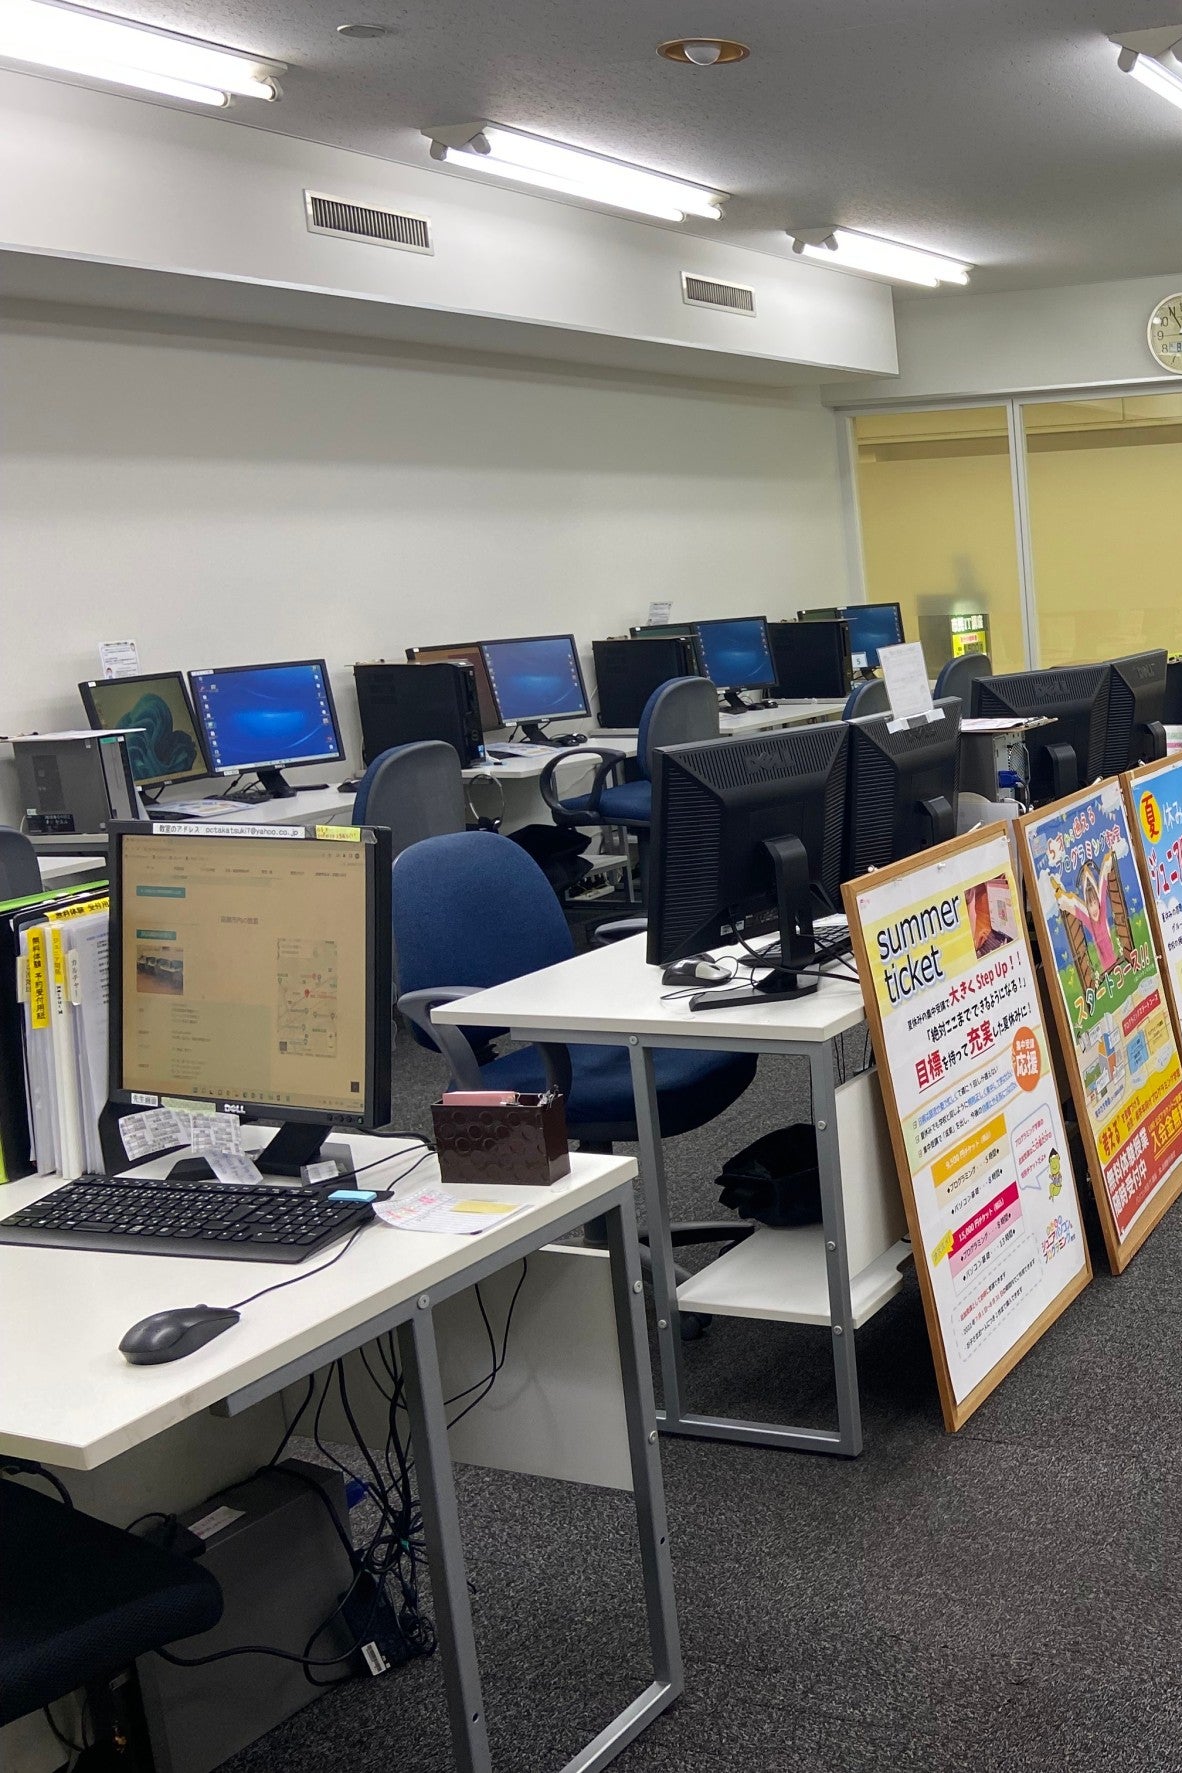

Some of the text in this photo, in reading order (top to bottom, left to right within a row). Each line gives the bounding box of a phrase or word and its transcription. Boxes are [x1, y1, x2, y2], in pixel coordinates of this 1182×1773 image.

[1157, 331, 1164, 340] 9
[1162, 344, 1168, 353] 8
[877, 895, 960, 960] summer
[884, 945, 943, 1003] ticket
[976, 970, 995, 990] Step
[1016, 1051, 1038, 1076] 応援
[224, 1104, 246, 1114] DELL
[1106, 1126, 1149, 1194] 無料体験授業
[1111, 1159, 1147, 1216] 随時受付中
